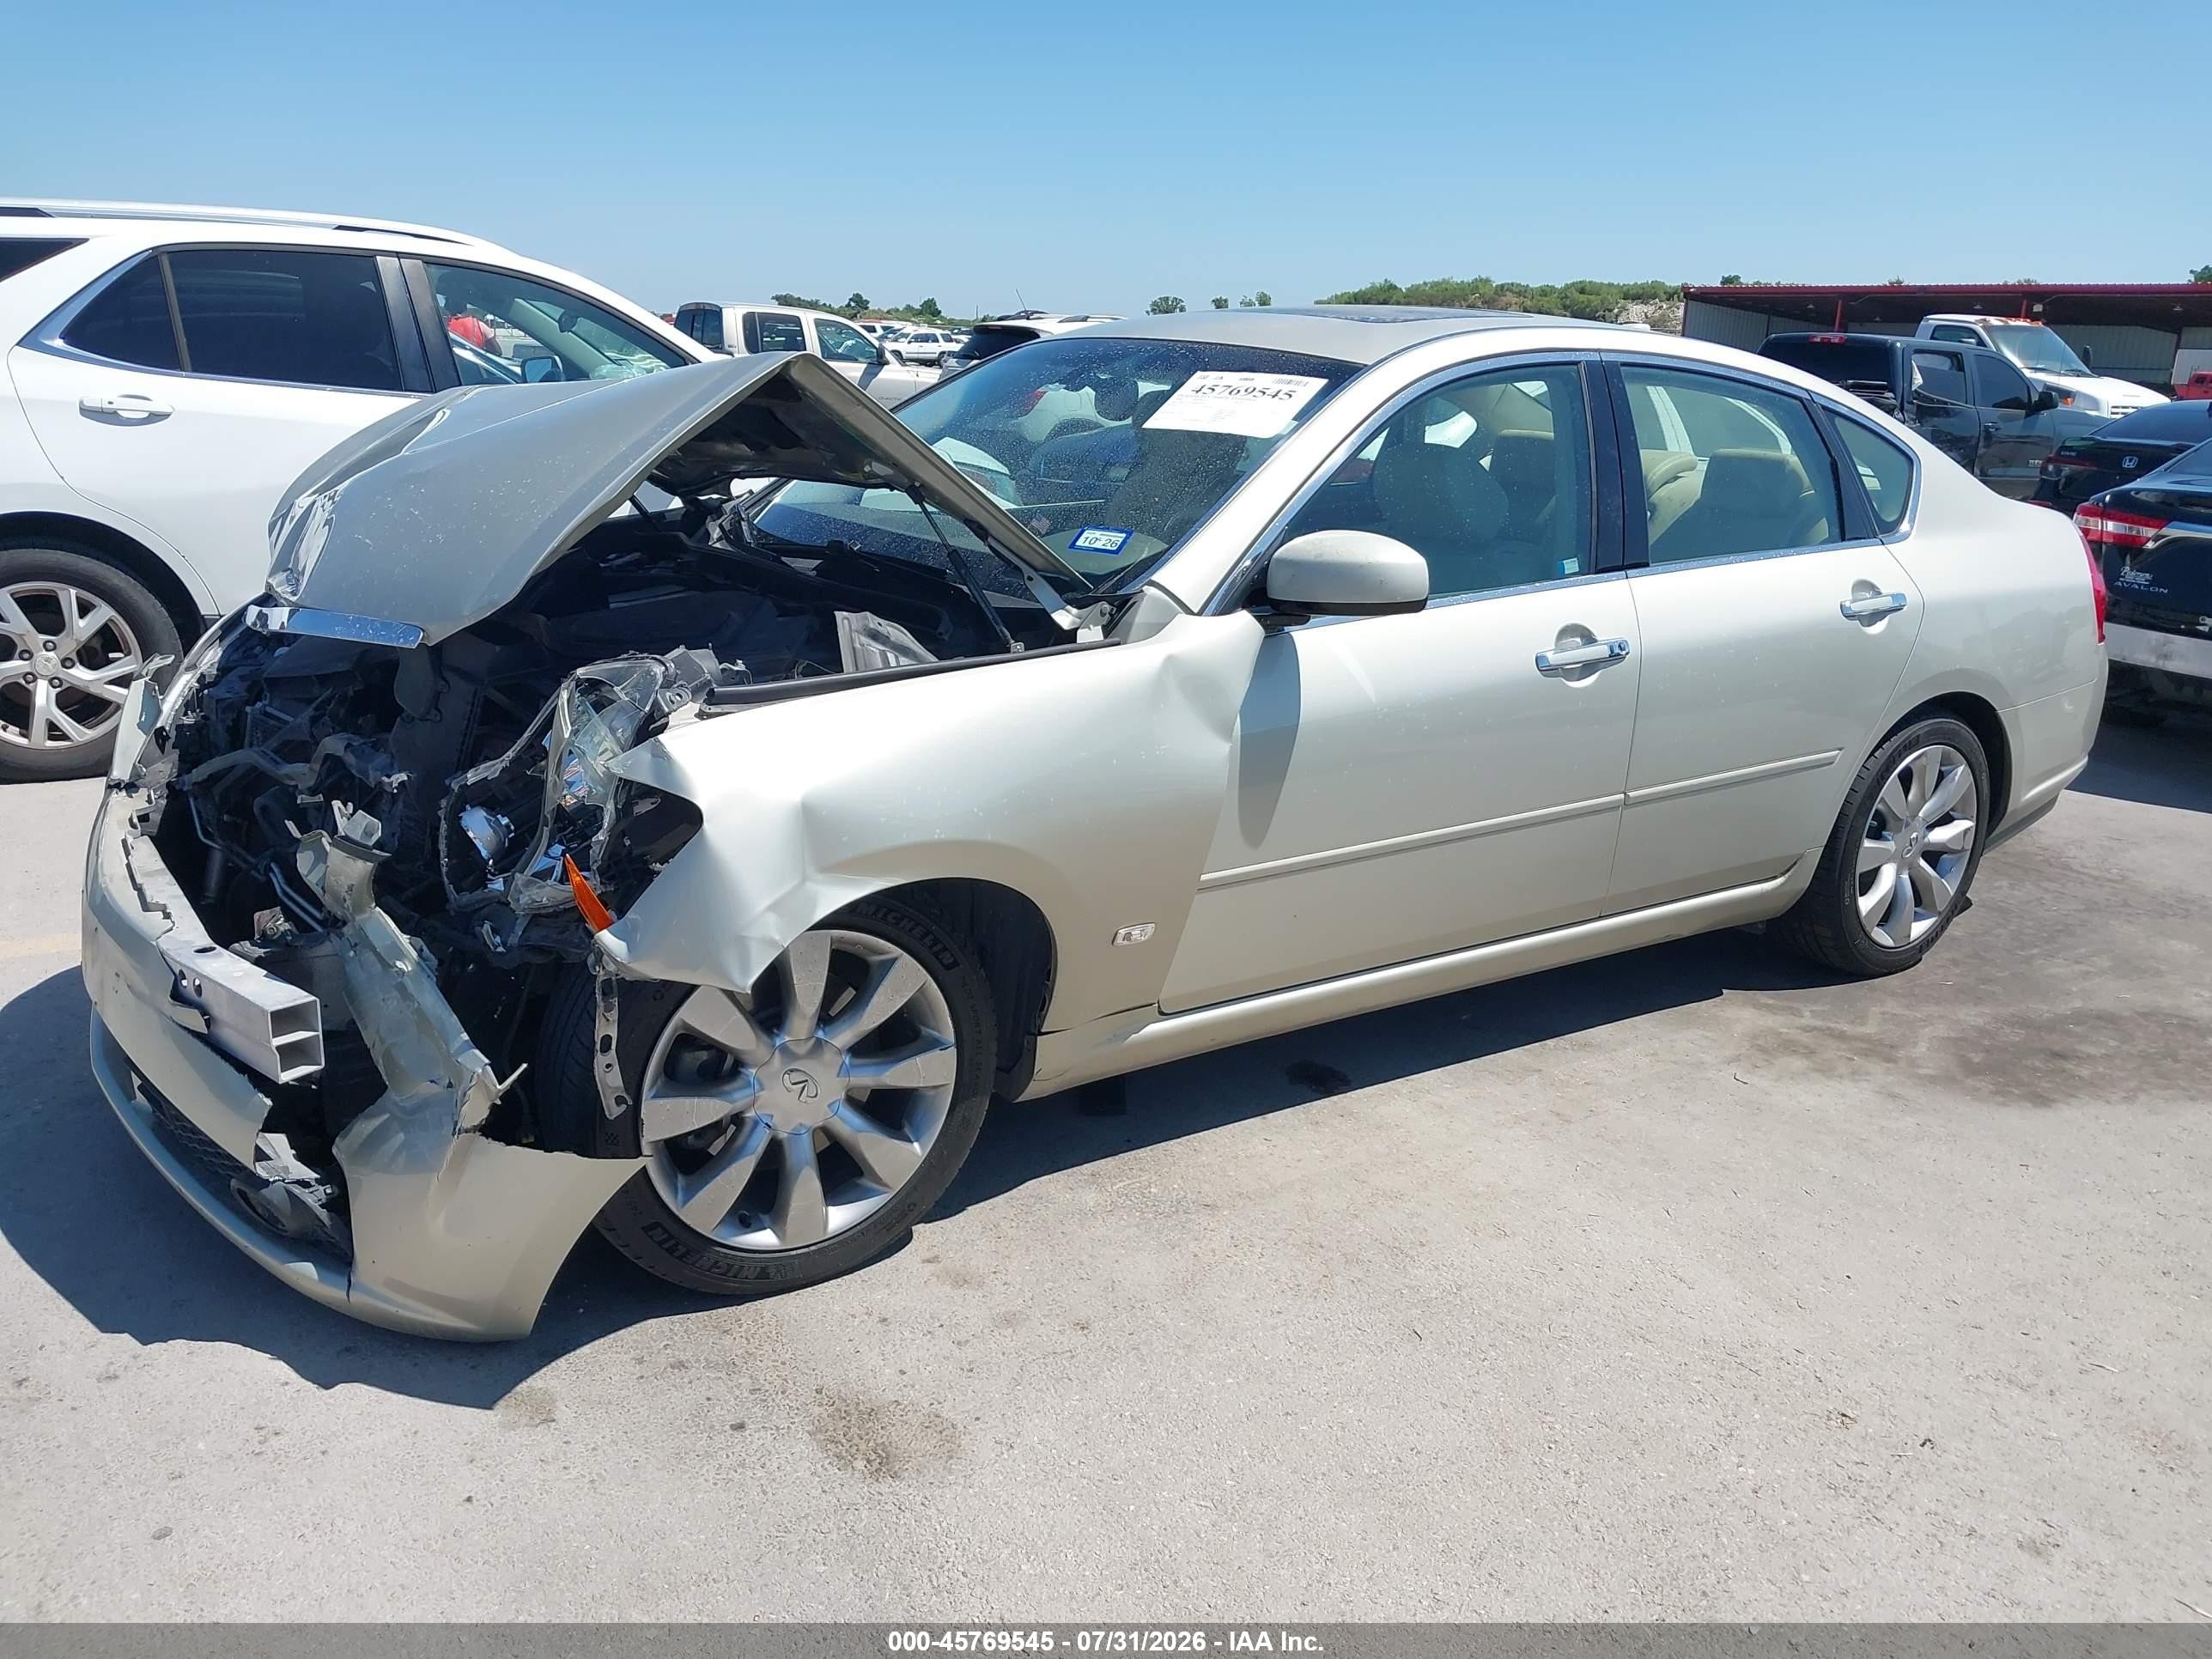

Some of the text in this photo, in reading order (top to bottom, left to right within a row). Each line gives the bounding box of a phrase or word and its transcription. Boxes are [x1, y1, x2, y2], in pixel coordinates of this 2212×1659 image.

[1191, 384, 1297, 401] 45769545
[1082, 536, 1121, 549] 10 26
[2112, 580, 2169, 594] AVALON
[855, 903, 957, 968] MICHELIN
[647, 1226, 763, 1280] MICHELIN
